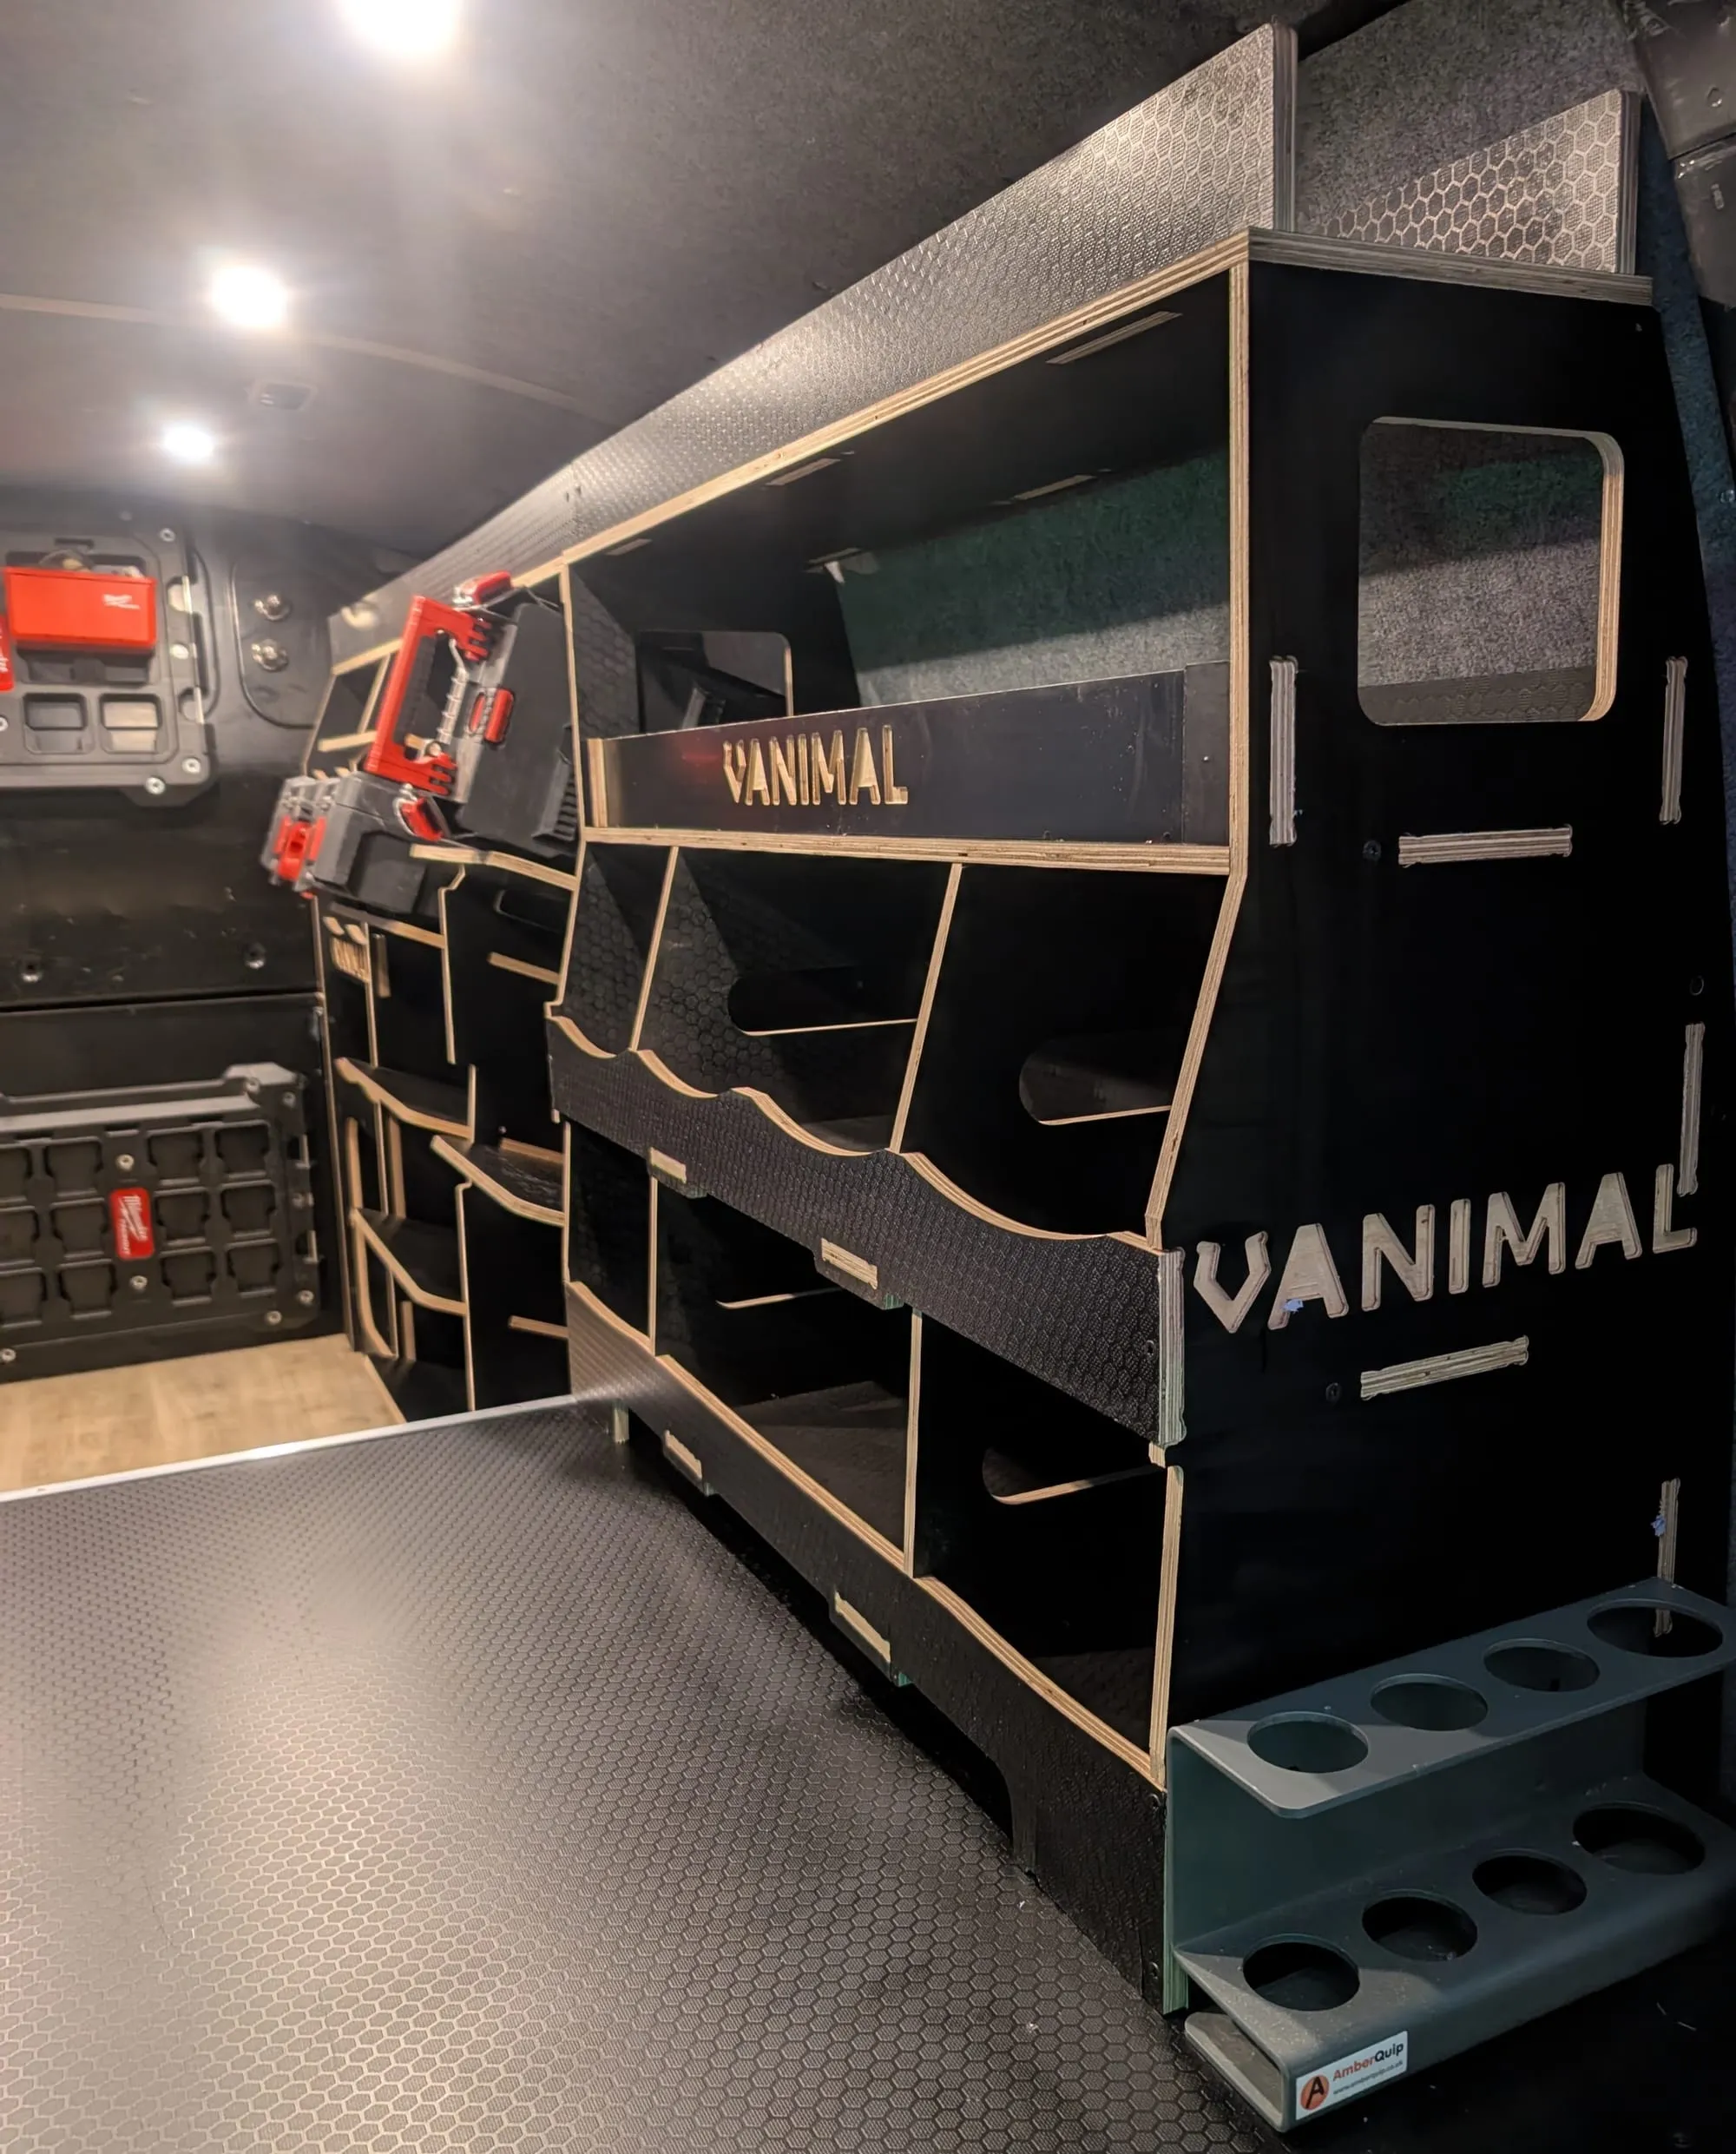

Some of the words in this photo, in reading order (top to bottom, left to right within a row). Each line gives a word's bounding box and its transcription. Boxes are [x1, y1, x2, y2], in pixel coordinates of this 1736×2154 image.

[722, 724, 909, 807] VANIMAL
[1194, 1163, 1697, 1334] VANIMAL
[1332, 2042, 1404, 2081] AmberQuip
